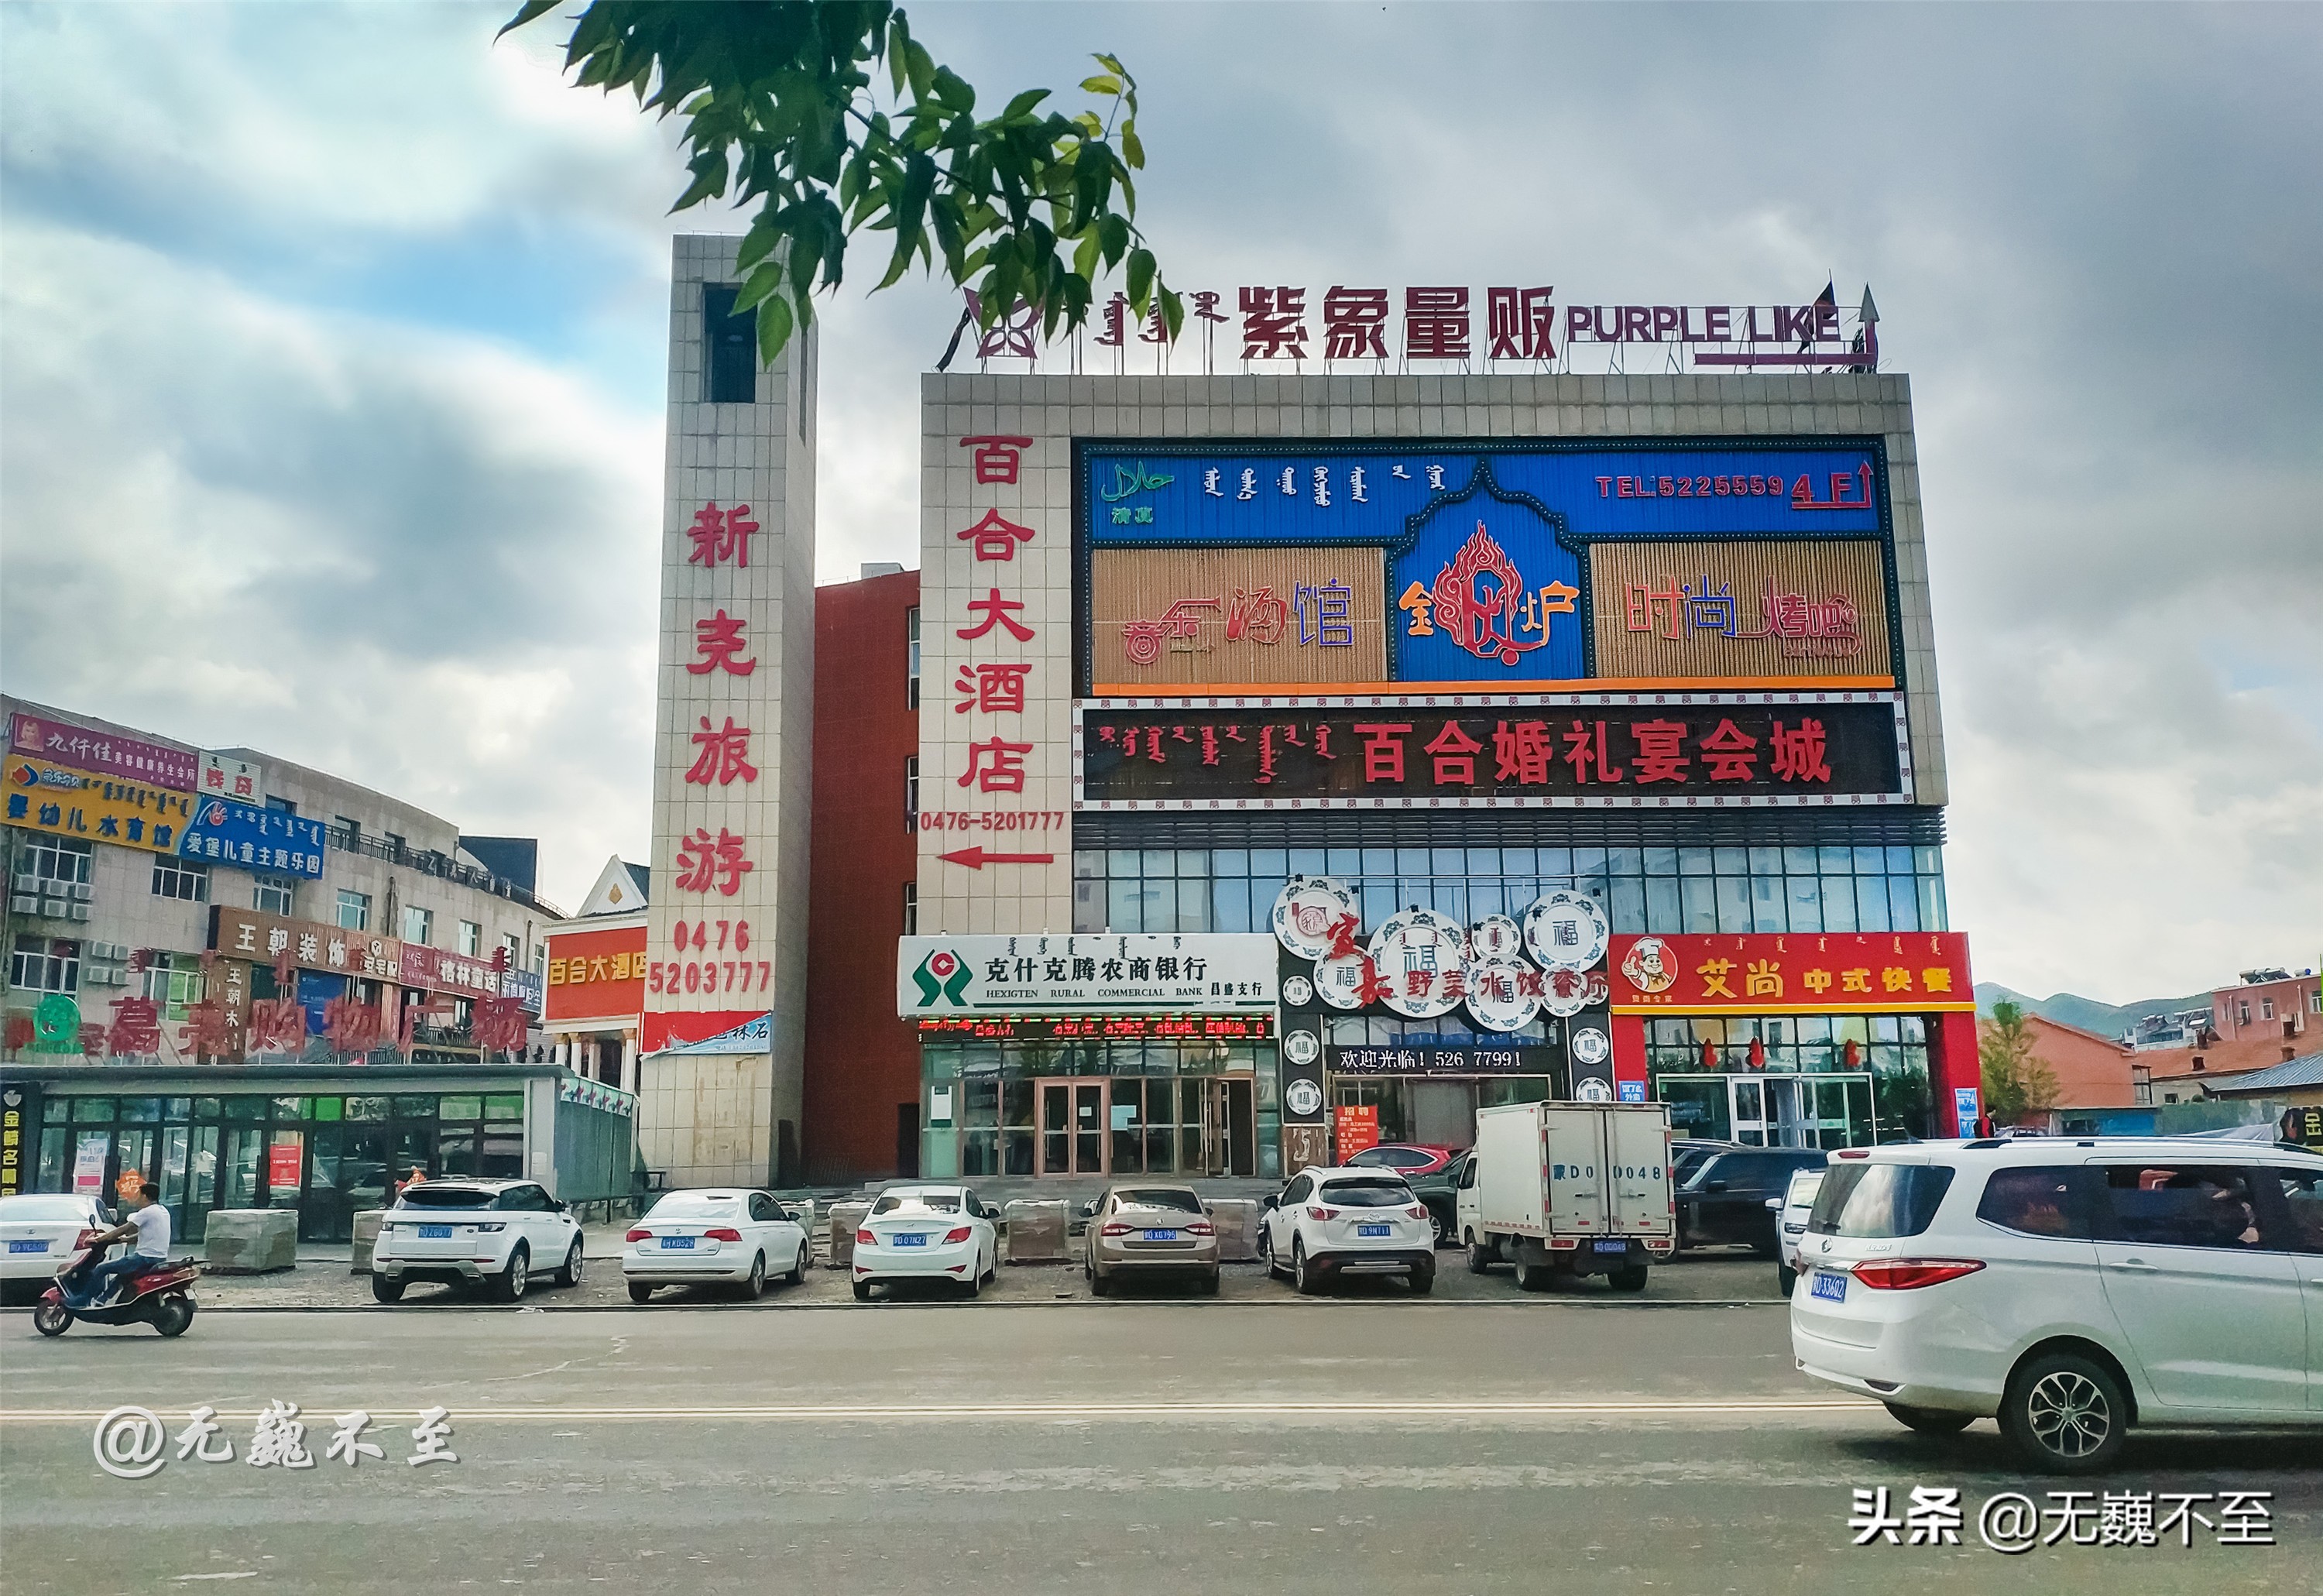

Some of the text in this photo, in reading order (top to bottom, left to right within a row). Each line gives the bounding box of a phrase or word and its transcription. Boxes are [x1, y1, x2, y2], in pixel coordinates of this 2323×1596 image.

[1239, 285, 1556, 360] 紫象量贩
[1567, 305, 1731, 342] PURPLE
[1747, 305, 1841, 342] LIKE
[955, 434, 1036, 794] 百合大酒店
[1353, 717, 1832, 784] 百合婚礼宴会城
[920, 811, 1065, 831] 0476-5201777
[235, 922, 346, 968] 王朝装饰
[674, 920, 750, 952] 0476
[649, 962, 770, 994] 5203777
[984, 956, 1208, 984] 克什克腾农商银行
[1696, 958, 1953, 999] 艾尚 中式快餐
[1050, 988, 1086, 997] RURAL
[1097, 987, 1165, 997] COMMERCIAL
[1175, 987, 1203, 996] BANK
[1434, 1051, 1465, 1068] 526
